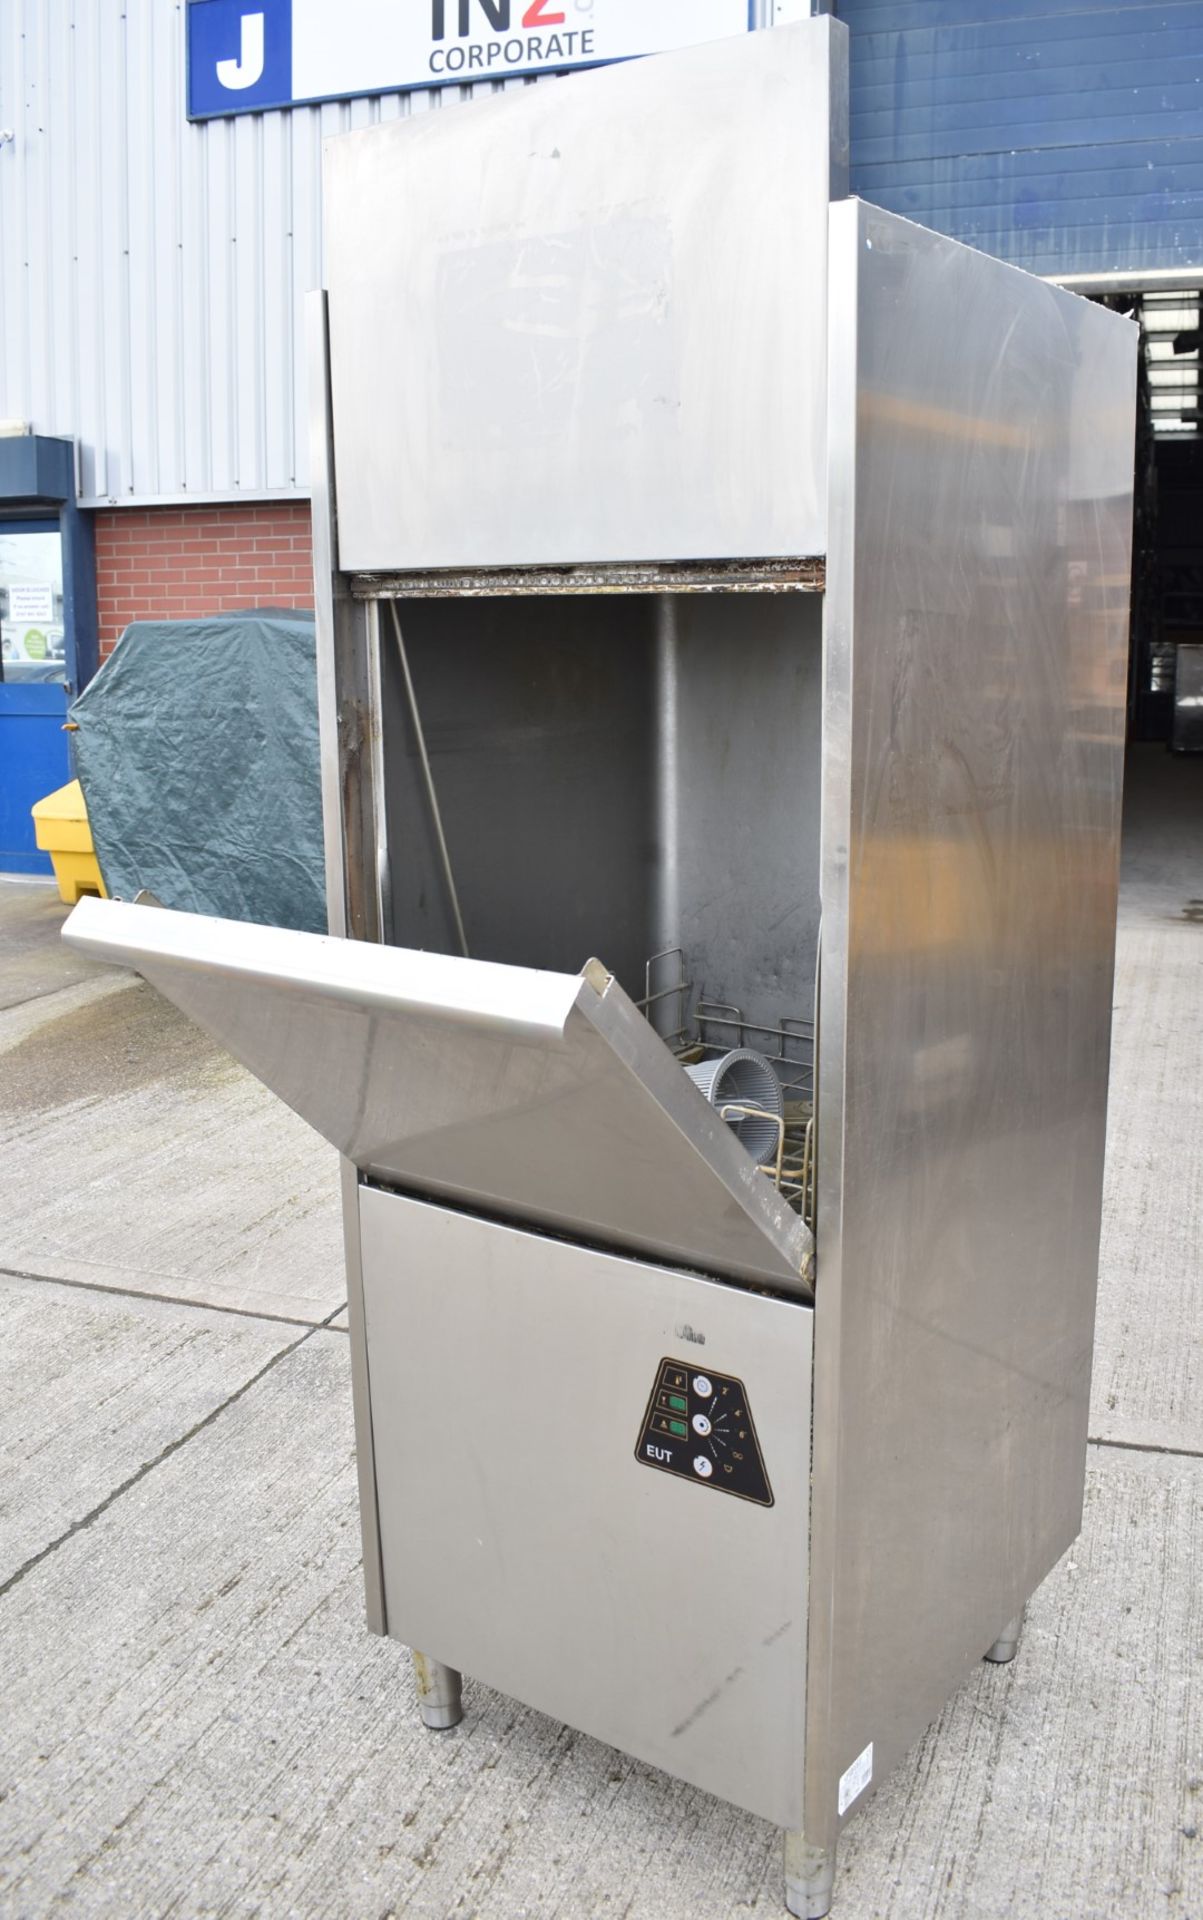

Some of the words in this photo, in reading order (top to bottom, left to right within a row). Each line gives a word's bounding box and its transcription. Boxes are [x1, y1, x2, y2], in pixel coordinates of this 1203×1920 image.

[216, 12, 264, 90] J
[429, 29, 594, 73] CORPORATE
[647, 1444, 672, 1463] EUT
